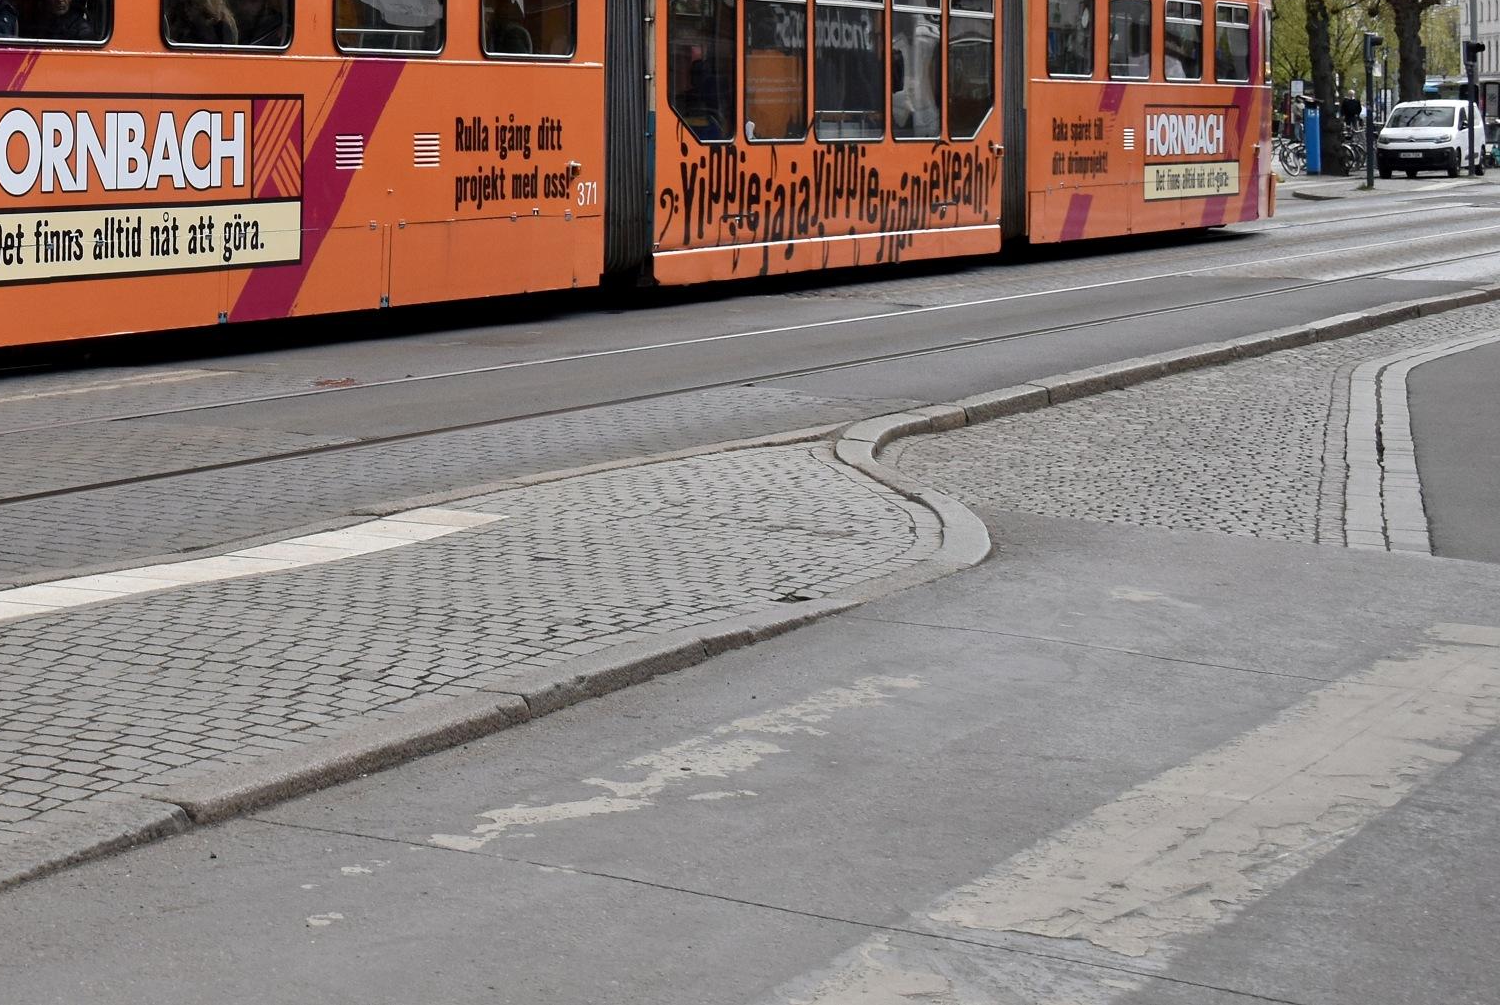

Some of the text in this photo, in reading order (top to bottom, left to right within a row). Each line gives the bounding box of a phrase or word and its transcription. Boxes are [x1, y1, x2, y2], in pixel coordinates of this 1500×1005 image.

[455, 114, 563, 160] Rulla igång ditt
[1145, 113, 1224, 157] HORNBACH
[455, 165, 570, 212] projekt med oss!
[577, 181, 598, 207] 371
[1155, 169, 1165, 192] Det
[33, 220, 84, 264] finns
[92, 216, 143, 261] alltid
[150, 212, 179, 257] nåt
[188, 215, 215, 255] att
[222, 213, 266, 263] göra.
